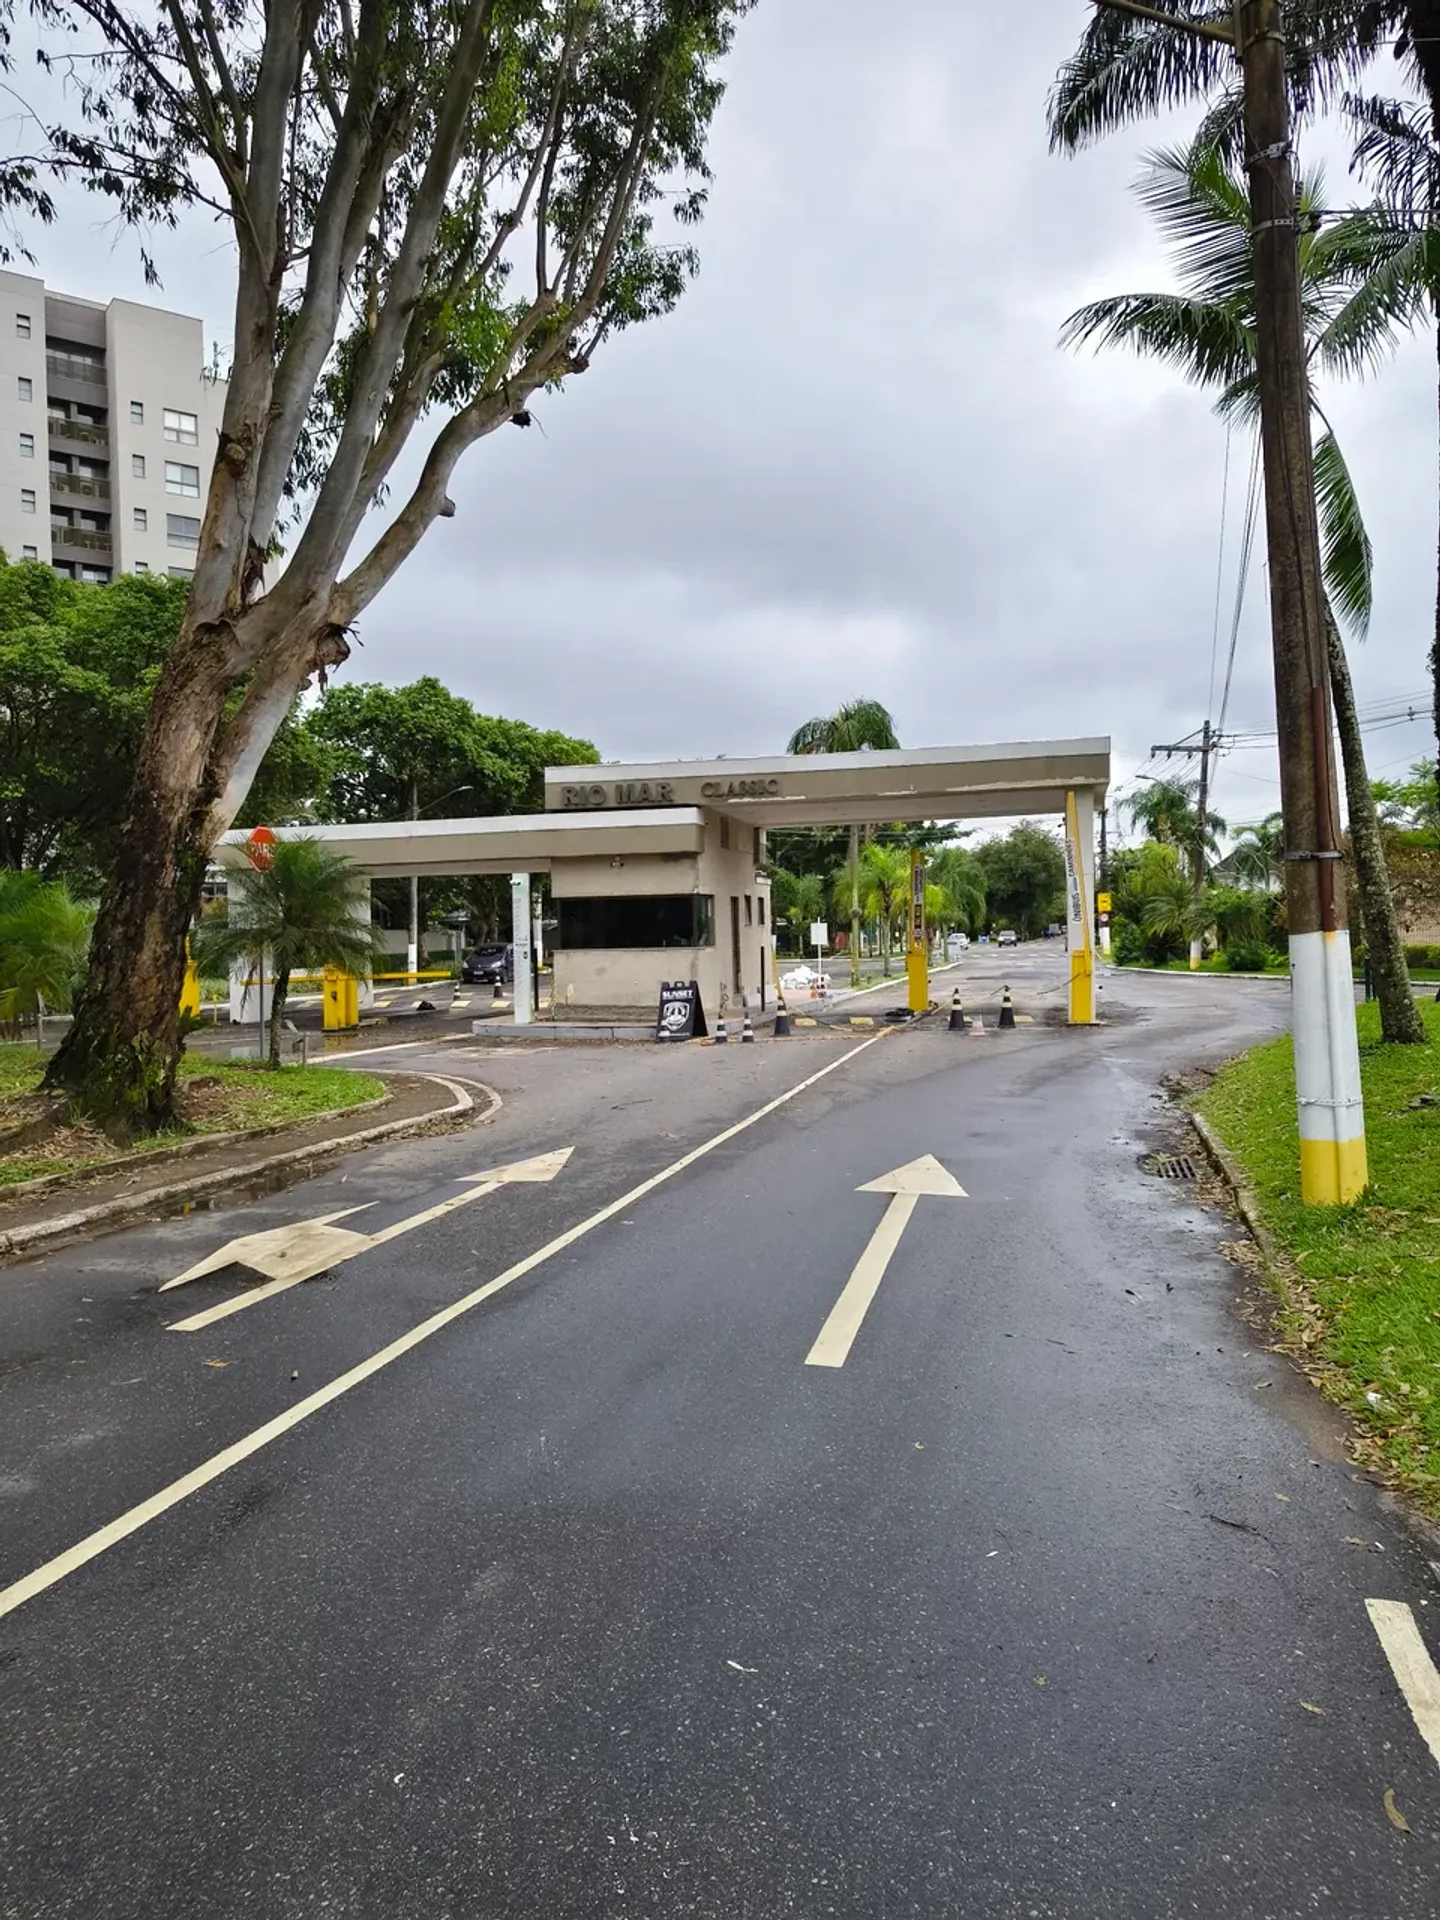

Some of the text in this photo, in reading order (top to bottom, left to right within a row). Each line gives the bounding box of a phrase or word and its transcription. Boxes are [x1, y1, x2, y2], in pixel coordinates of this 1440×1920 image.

[561, 779, 779, 806] RIO MAR CLASSIC
[662, 990, 693, 999] SUNSET
